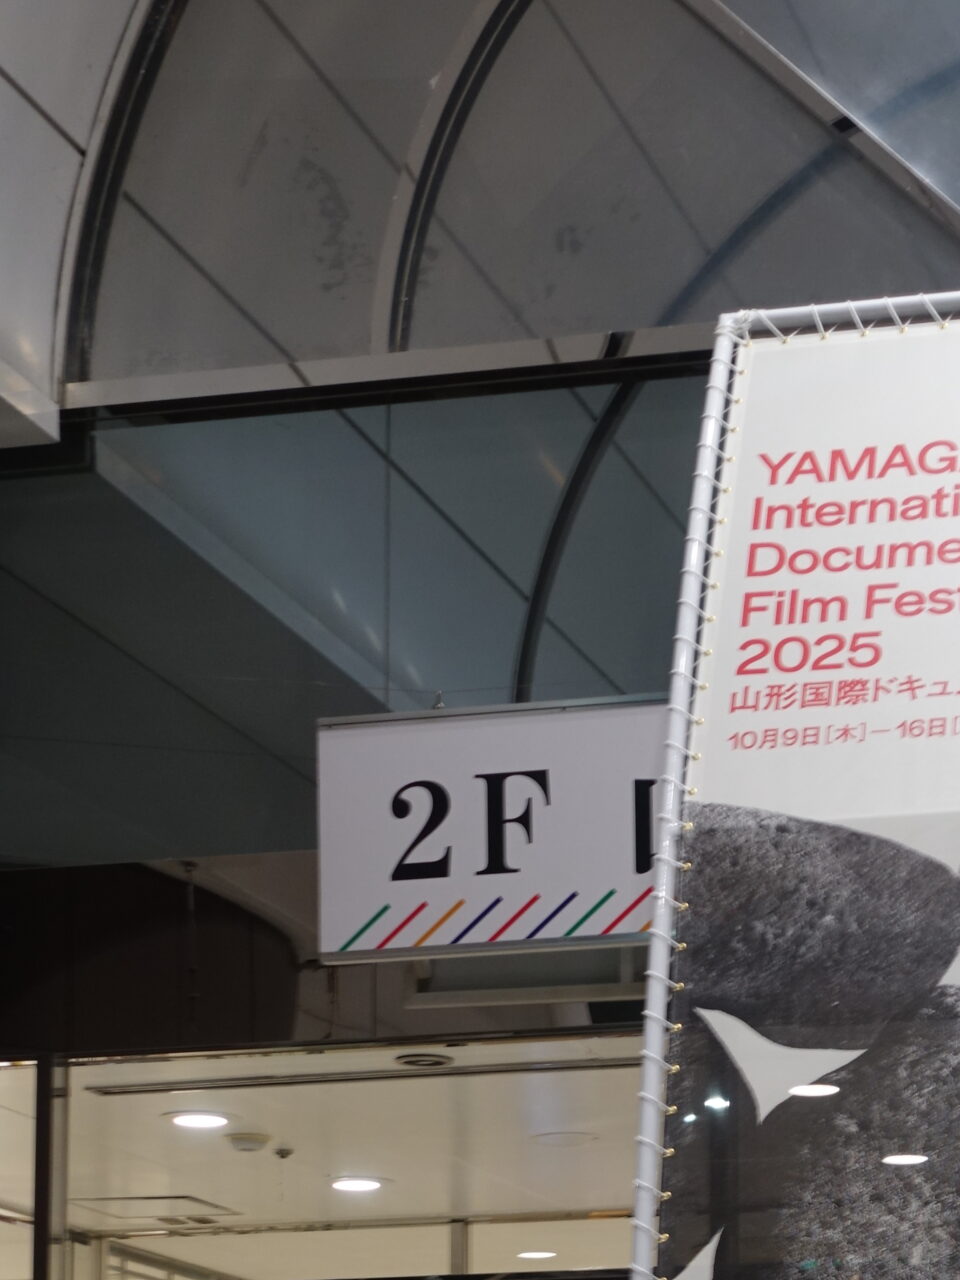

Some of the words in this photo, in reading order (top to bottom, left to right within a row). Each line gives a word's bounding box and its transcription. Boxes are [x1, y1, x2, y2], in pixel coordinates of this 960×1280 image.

[740, 589, 848, 628] Film
[735, 631, 883, 676] 2025
[390, 769, 552, 881] 2F
